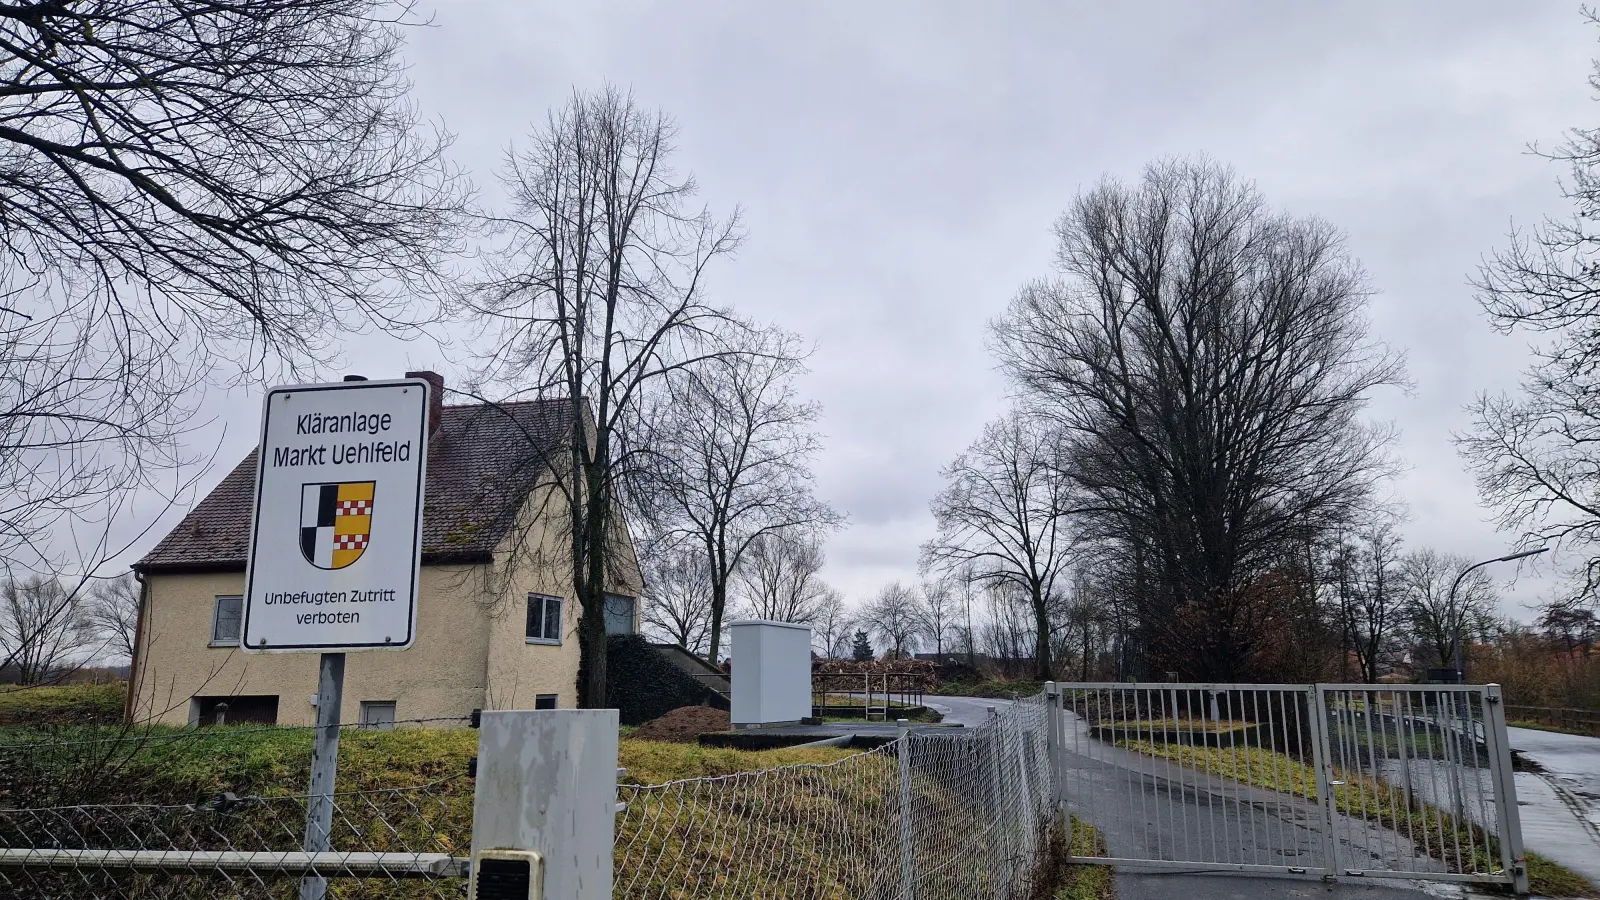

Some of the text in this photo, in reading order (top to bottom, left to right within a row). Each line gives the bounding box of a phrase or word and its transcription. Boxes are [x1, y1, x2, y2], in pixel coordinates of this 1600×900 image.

[296, 411, 392, 435] Kläranlage
[273, 440, 411, 468] Markt Uehlfeld
[264, 588, 396, 606] Unbefugten Zutritt
[296, 610, 360, 625] verboten
